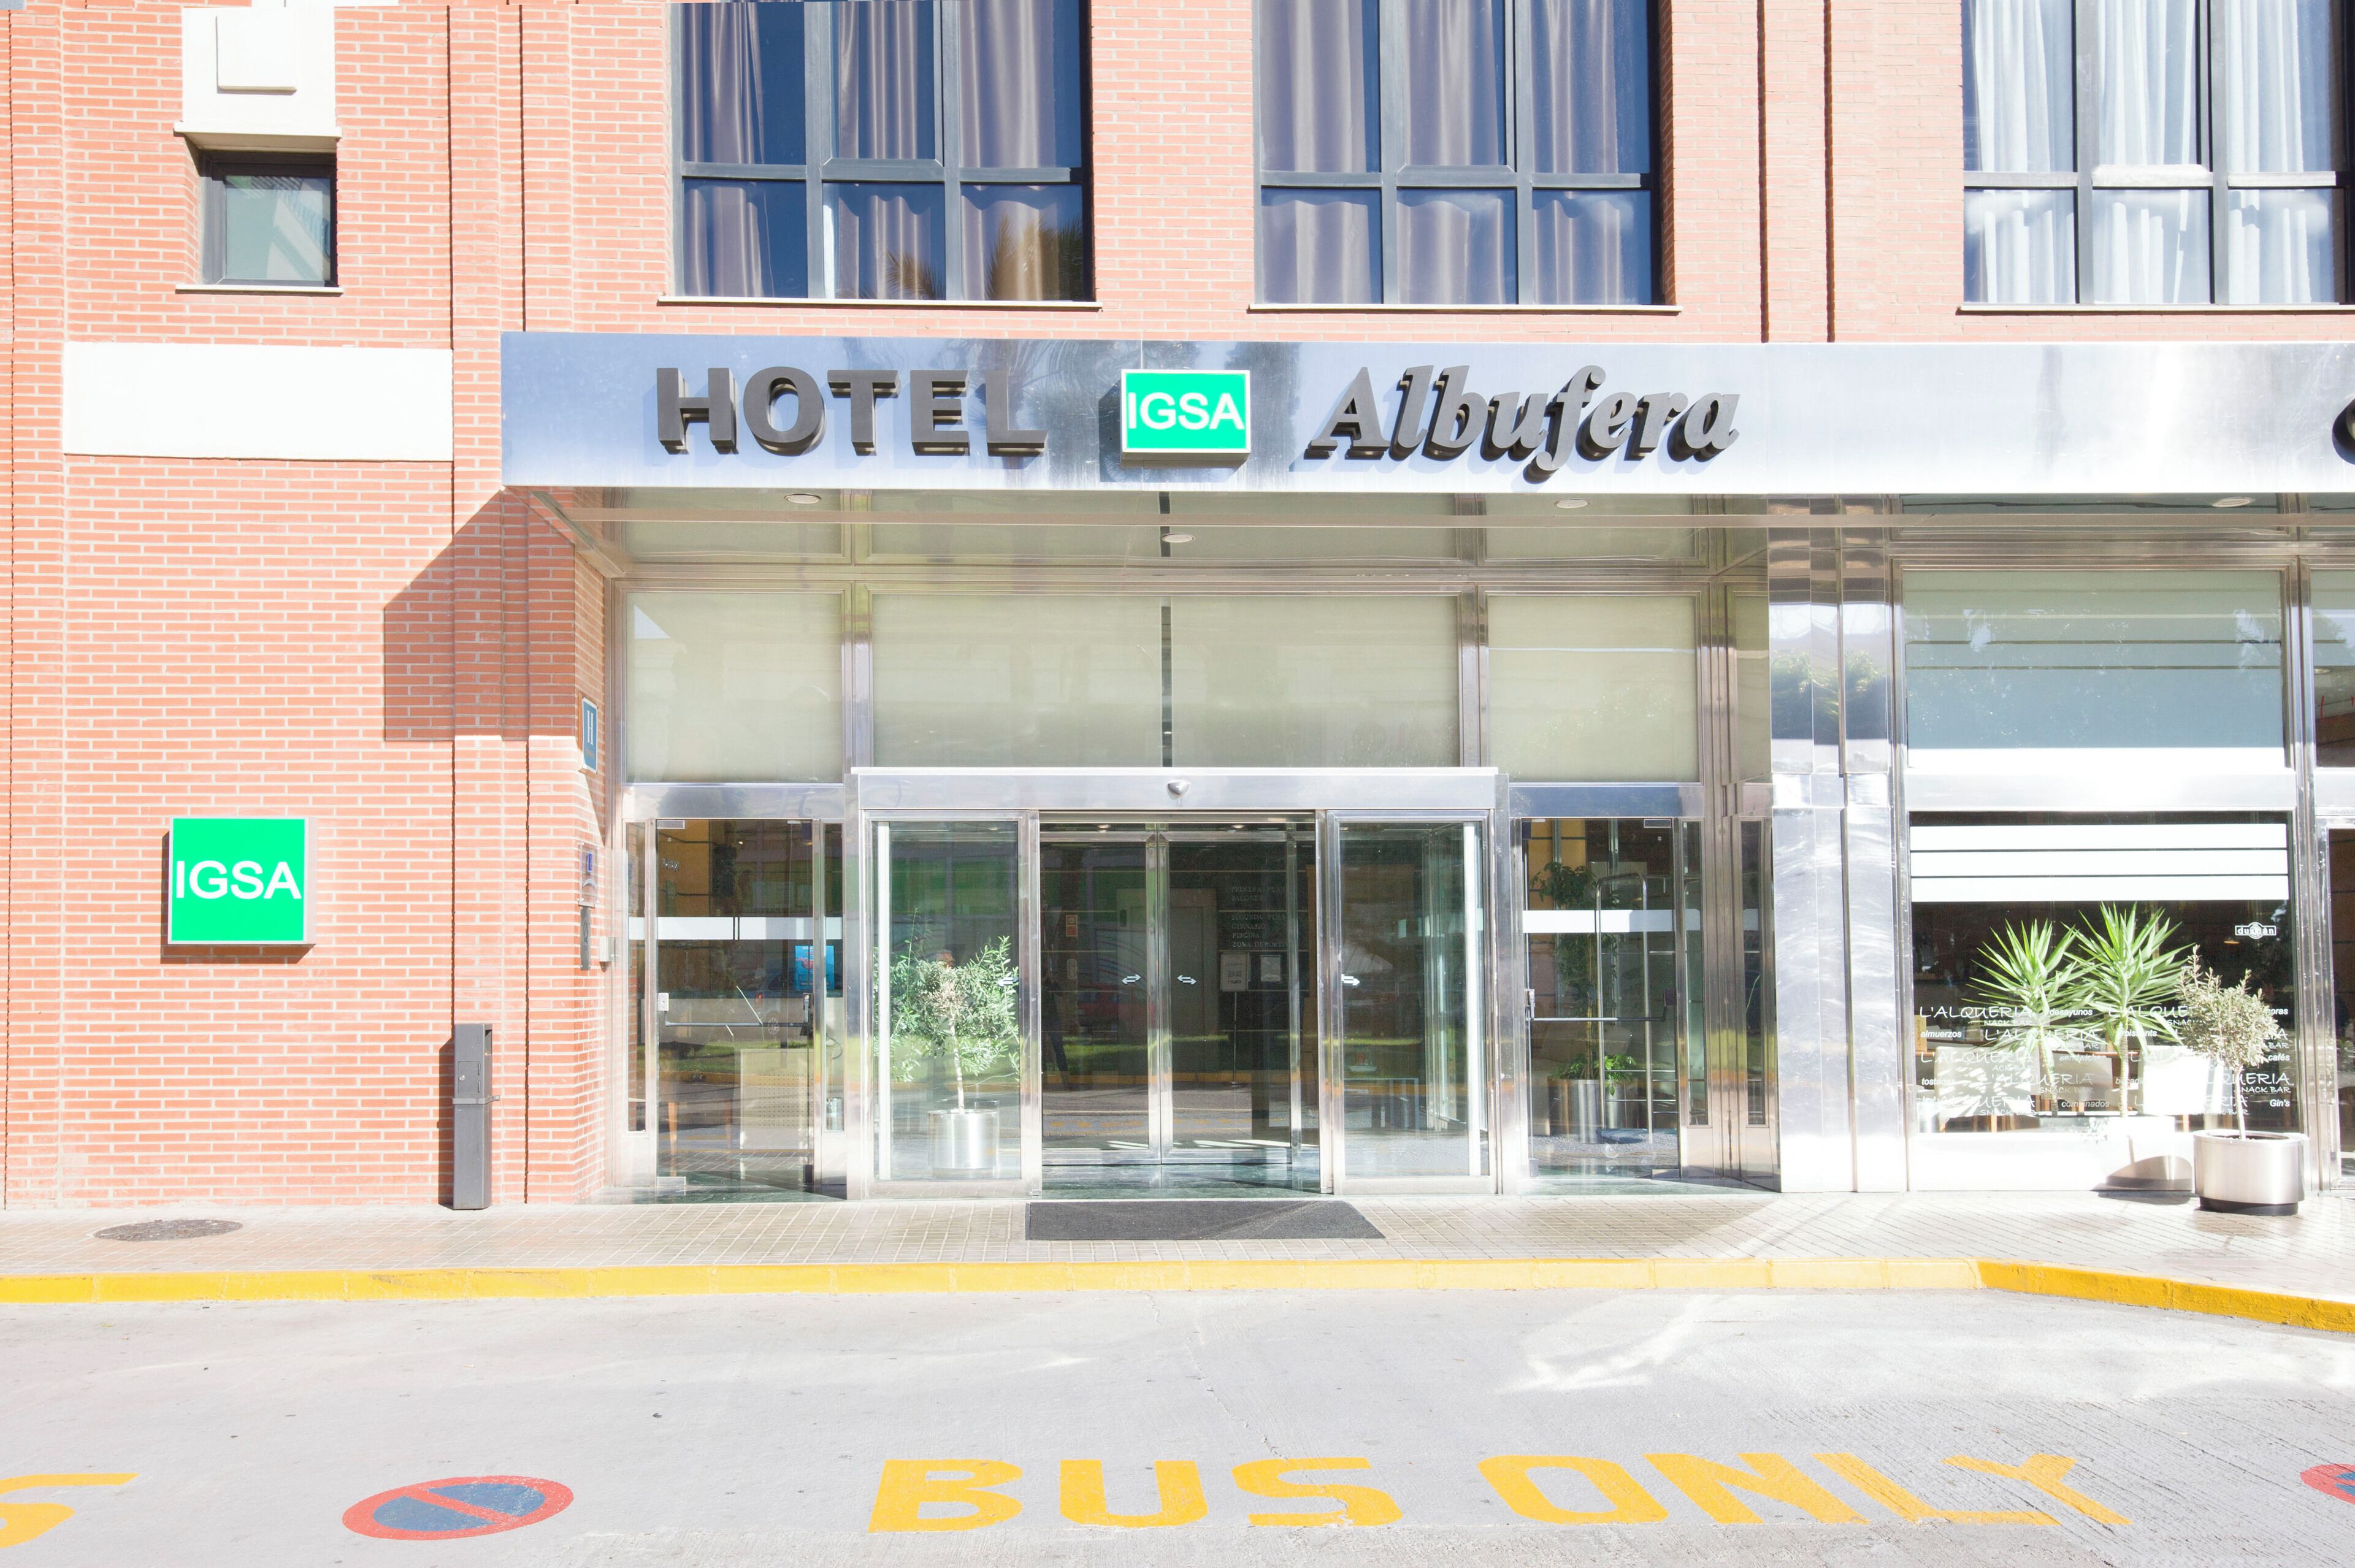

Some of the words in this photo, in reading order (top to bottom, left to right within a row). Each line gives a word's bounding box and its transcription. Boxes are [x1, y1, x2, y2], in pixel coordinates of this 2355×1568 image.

[656, 366, 1047, 451] HOTEL
[1127, 391, 1246, 431] IGSA
[1306, 365, 1740, 480] Albufera
[175, 859, 302, 900] IGSA
[1920, 1006, 2032, 1019] L'ALQUERIA
[2050, 1007, 2093, 1017] desayunos
[1920, 1030, 1962, 1039] almuerzos
[2268, 1053, 2290, 1061] cafés
[2270, 1098, 2291, 1107] Gin's
[868, 1458, 1403, 1533] BUS
[1477, 1453, 2133, 1525] ONLY
